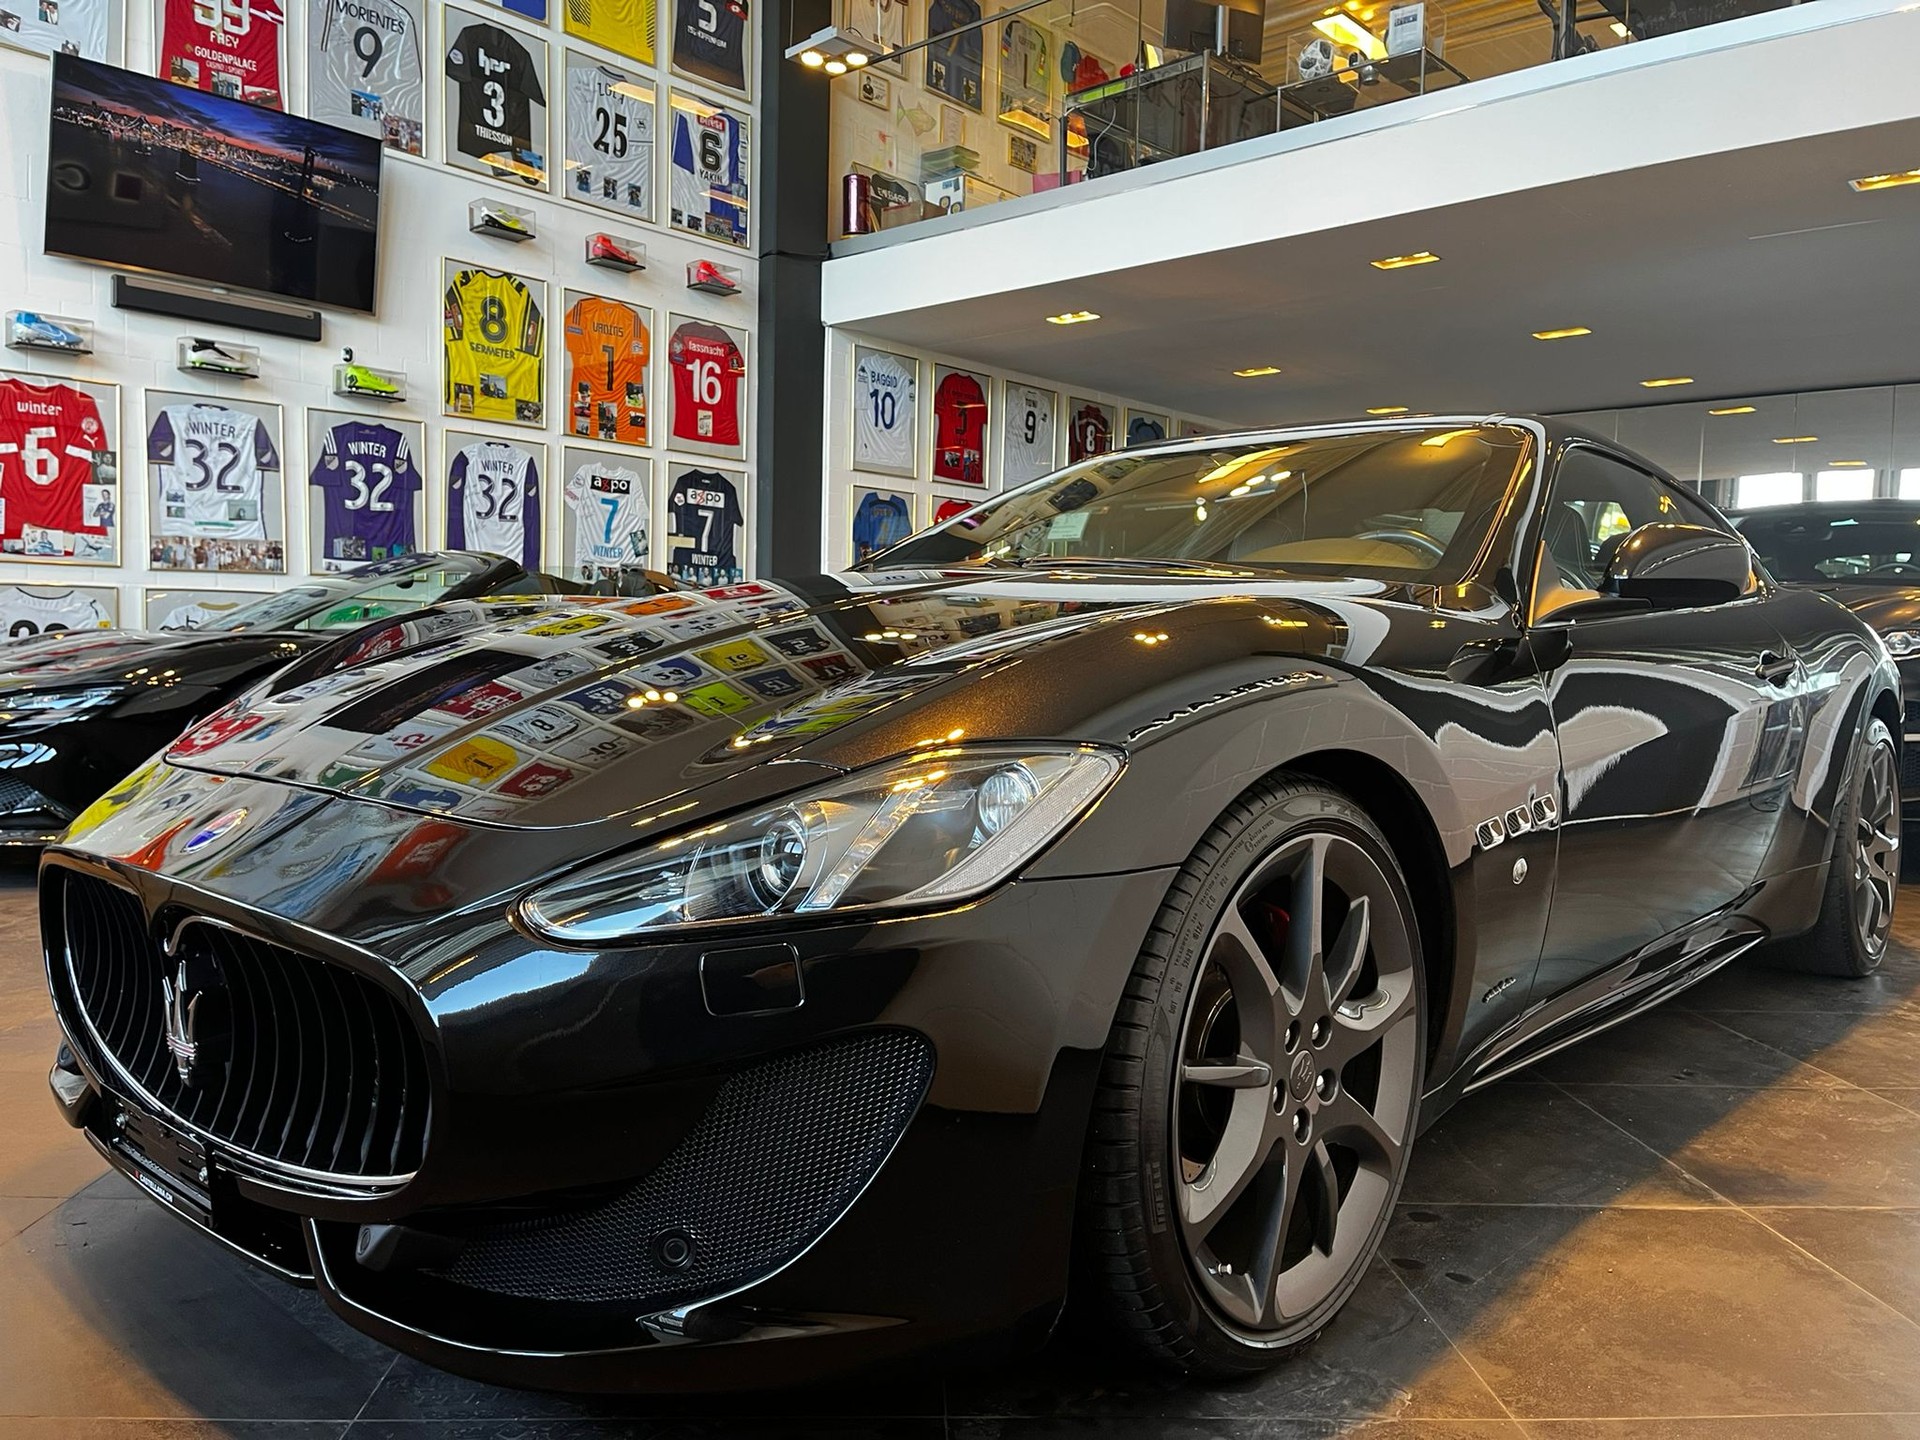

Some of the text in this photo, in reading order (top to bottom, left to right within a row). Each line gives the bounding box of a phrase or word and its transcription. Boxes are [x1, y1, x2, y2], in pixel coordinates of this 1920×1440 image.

[335, 0, 405, 35] MORIENTES
[194, 45, 258, 72] GOLDENPALACE
[209, 30, 240, 49] FREY
[353, 26, 383, 78] 9
[482, 80, 505, 128] 3
[593, 106, 628, 159] 25
[699, 129, 722, 173] 6
[699, 168, 723, 184] YAKIN
[479, 295, 509, 344] 8
[602, 344, 615, 391] 1
[686, 358, 722, 405] 16
[870, 371, 898, 388] BAGGIO
[16, 400, 63, 417] winter
[188, 420, 236, 439] WINTER
[869, 388, 896, 430] 10
[1024, 410, 1036, 444] 9
[24, 426, 59, 486] 6
[347, 441, 387, 459] WINTER
[1085, 424, 1096, 452] 8
[184, 439, 246, 494] 32
[344, 460, 395, 512] 32
[481, 459, 515, 476] WINTER
[475, 473, 519, 523] 32
[601, 497, 620, 544] 7
[697, 508, 714, 553] 7
[592, 544, 623, 560] WINTER
[691, 553, 718, 566] WINTER
